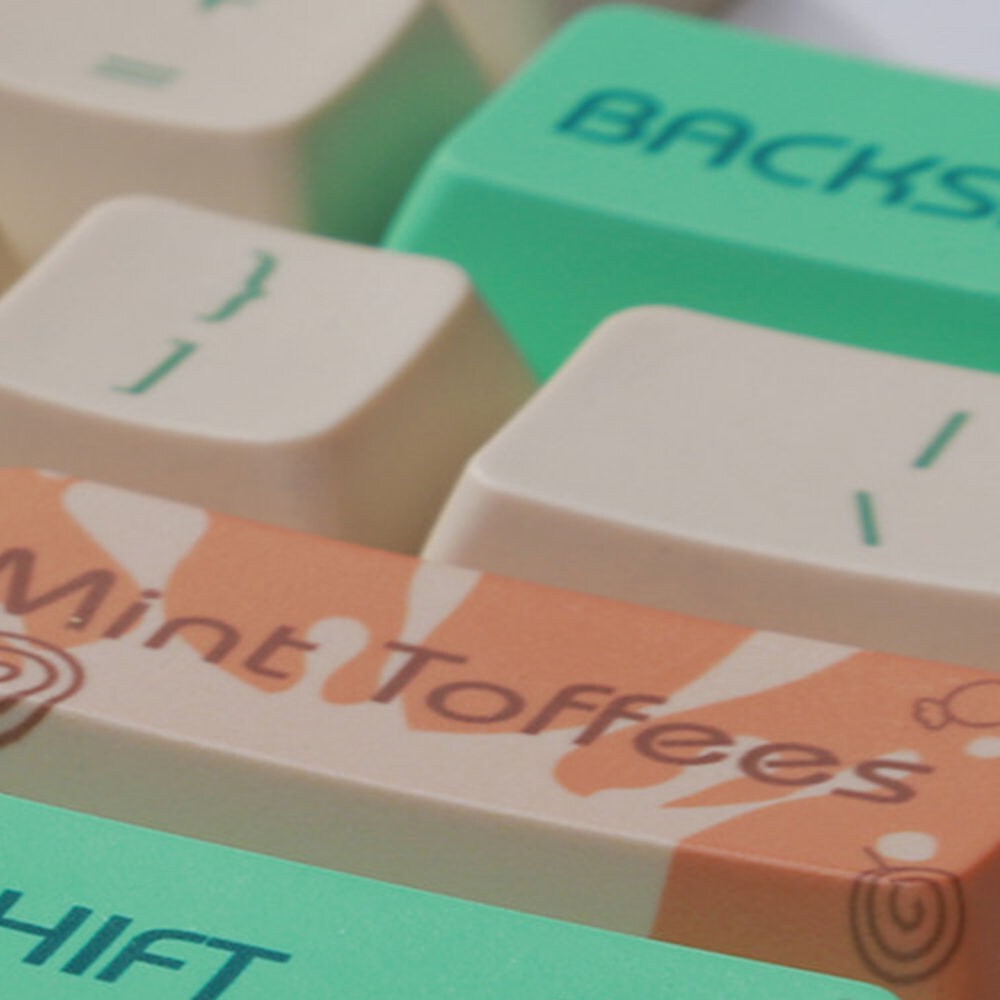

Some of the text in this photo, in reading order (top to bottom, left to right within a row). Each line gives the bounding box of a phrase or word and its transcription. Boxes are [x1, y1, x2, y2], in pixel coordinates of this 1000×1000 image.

[552, 87, 1000, 221] BACKS
[195, 249, 279, 325] }
[369, 640, 937, 805] Toffees
